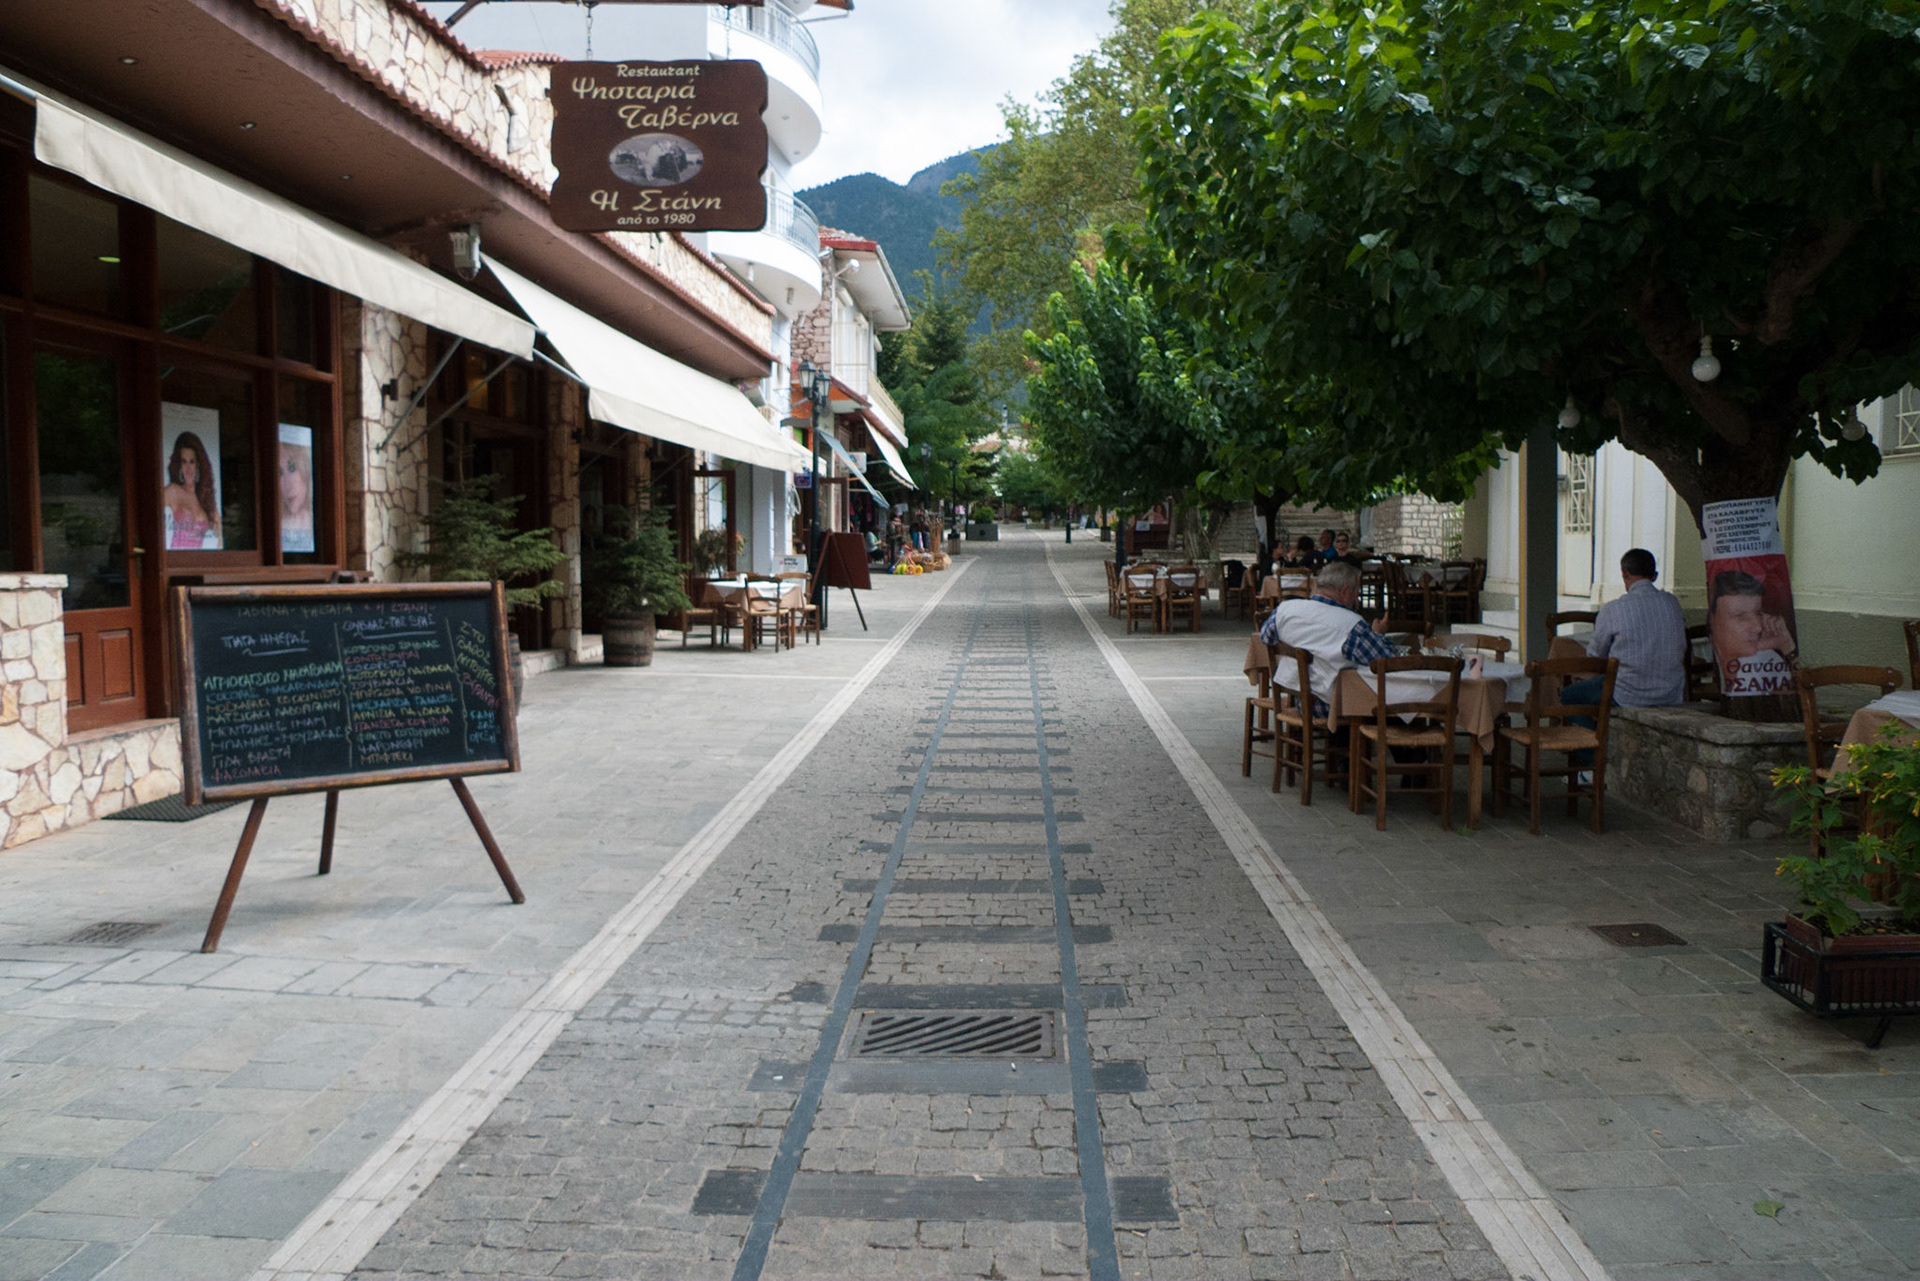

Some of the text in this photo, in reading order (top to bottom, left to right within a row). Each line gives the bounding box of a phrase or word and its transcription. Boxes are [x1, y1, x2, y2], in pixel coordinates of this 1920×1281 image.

[616, 64, 700, 78] Restaurant
[571, 77, 697, 103] Ψησταριά
[618, 104, 740, 130] Ταβέρνα
[590, 189, 722, 212] Η Στάνη
[617, 213, 696, 225] από το 1980
